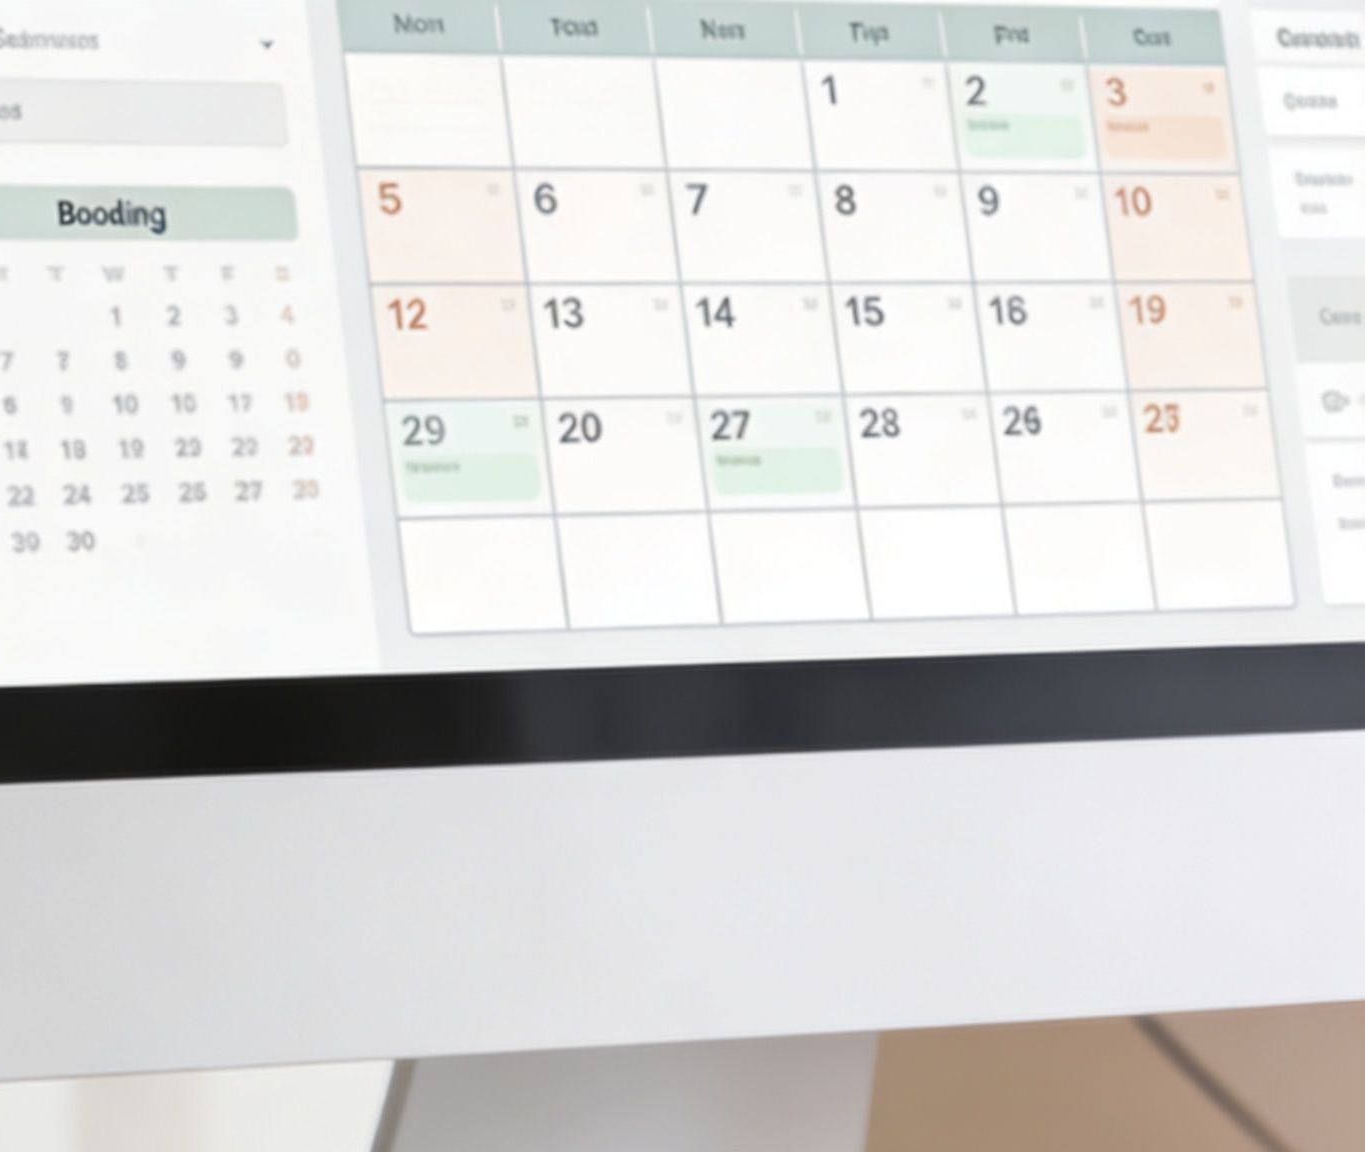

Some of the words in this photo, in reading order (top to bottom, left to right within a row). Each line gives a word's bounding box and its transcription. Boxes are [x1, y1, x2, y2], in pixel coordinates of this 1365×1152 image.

[821, 74, 837, 105] 1
[965, 74, 986, 107] 2
[1105, 76, 1128, 108] 3
[378, 181, 403, 216] 5
[533, 182, 558, 215] 6
[686, 183, 708, 216] 7
[834, 184, 857, 216] 8
[977, 185, 1000, 217] 9
[1114, 185, 1153, 217] 10
[167, 304, 181, 327] 2
[224, 304, 240, 327] 3
[279, 304, 295, 325] 4
[388, 297, 427, 331] 12
[543, 296, 585, 329] 13
[696, 296, 736, 328] 14
[845, 295, 885, 327] 15
[989, 295, 1028, 326] 16
[1128, 294, 1167, 325] 19
[0, 350, 14, 371] 7
[402, 415, 446, 447] 29
[558, 412, 603, 444] 20
[711, 410, 750, 441] 27
[860, 408, 901, 439] 28
[1003, 405, 1042, 436] 26
[63, 483, 92, 506] 24
[66, 529, 96, 553] 30
